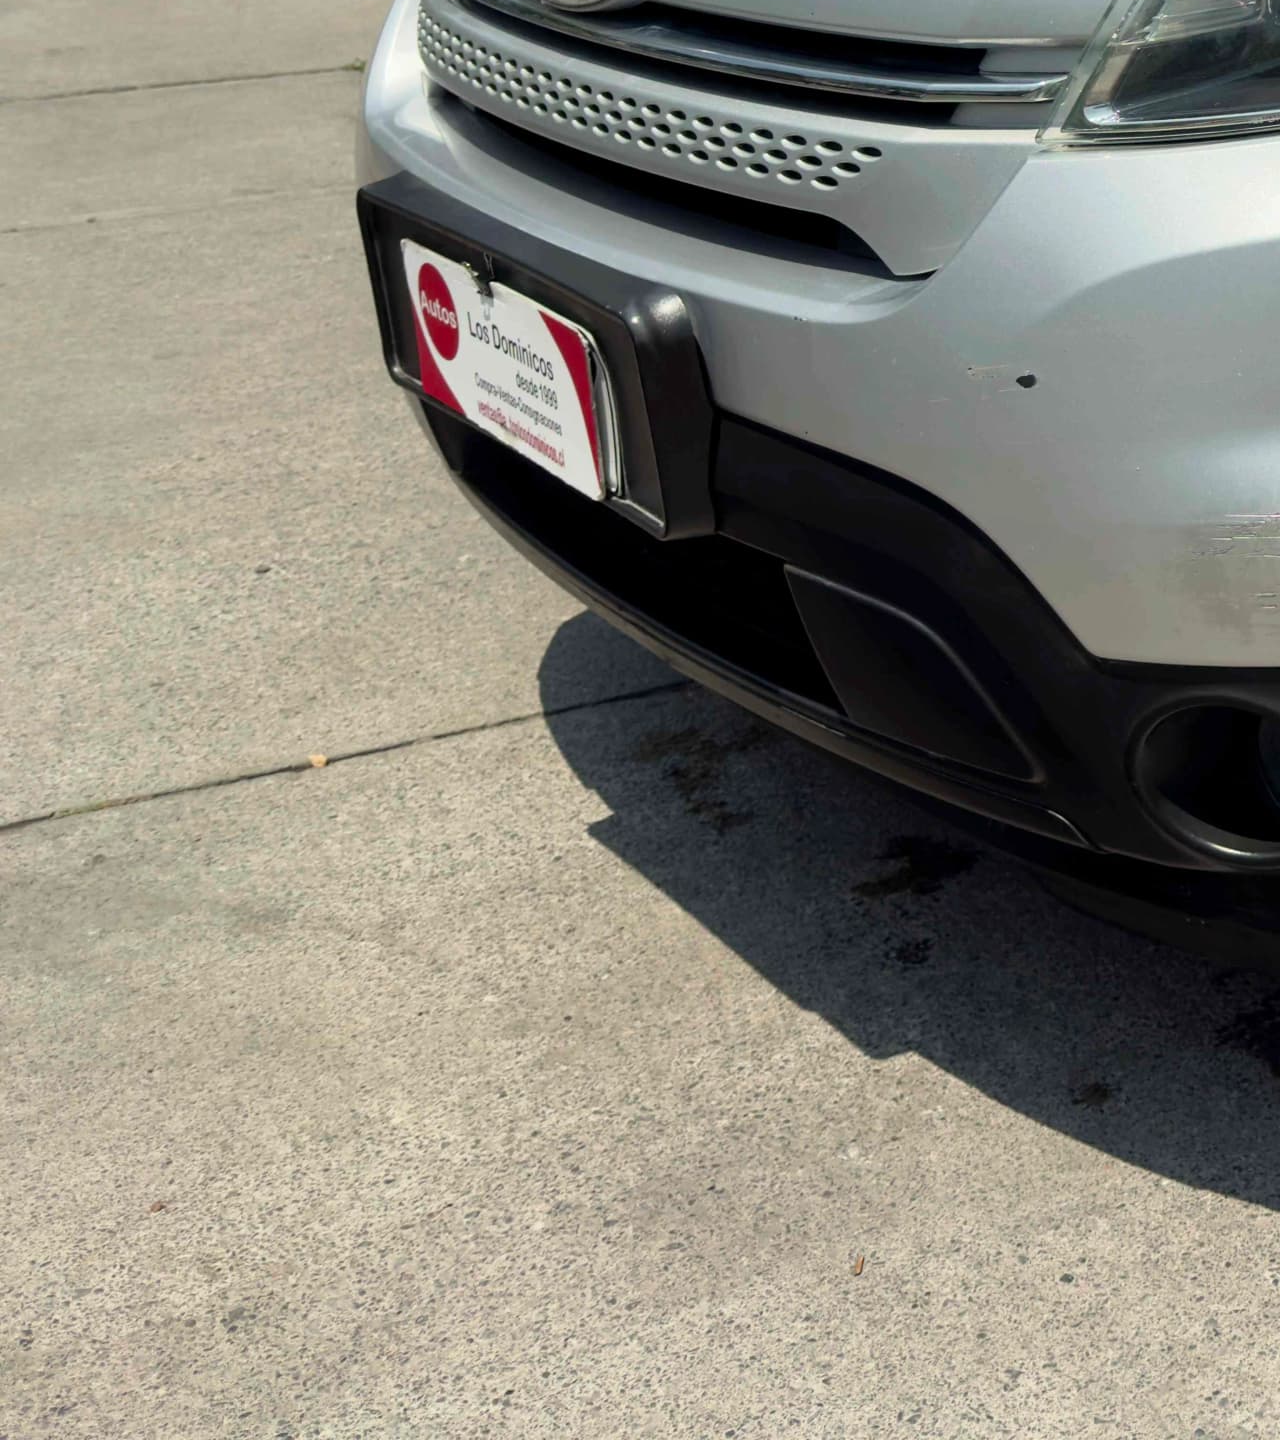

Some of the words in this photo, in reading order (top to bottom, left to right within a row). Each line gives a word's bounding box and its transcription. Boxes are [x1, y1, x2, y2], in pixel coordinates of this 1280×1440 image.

[418, 291, 458, 329] Autos
[467, 310, 490, 344] Los
[492, 325, 554, 381] Dominicos
[515, 370, 540, 399] desde
[539, 383, 559, 411] 1999
